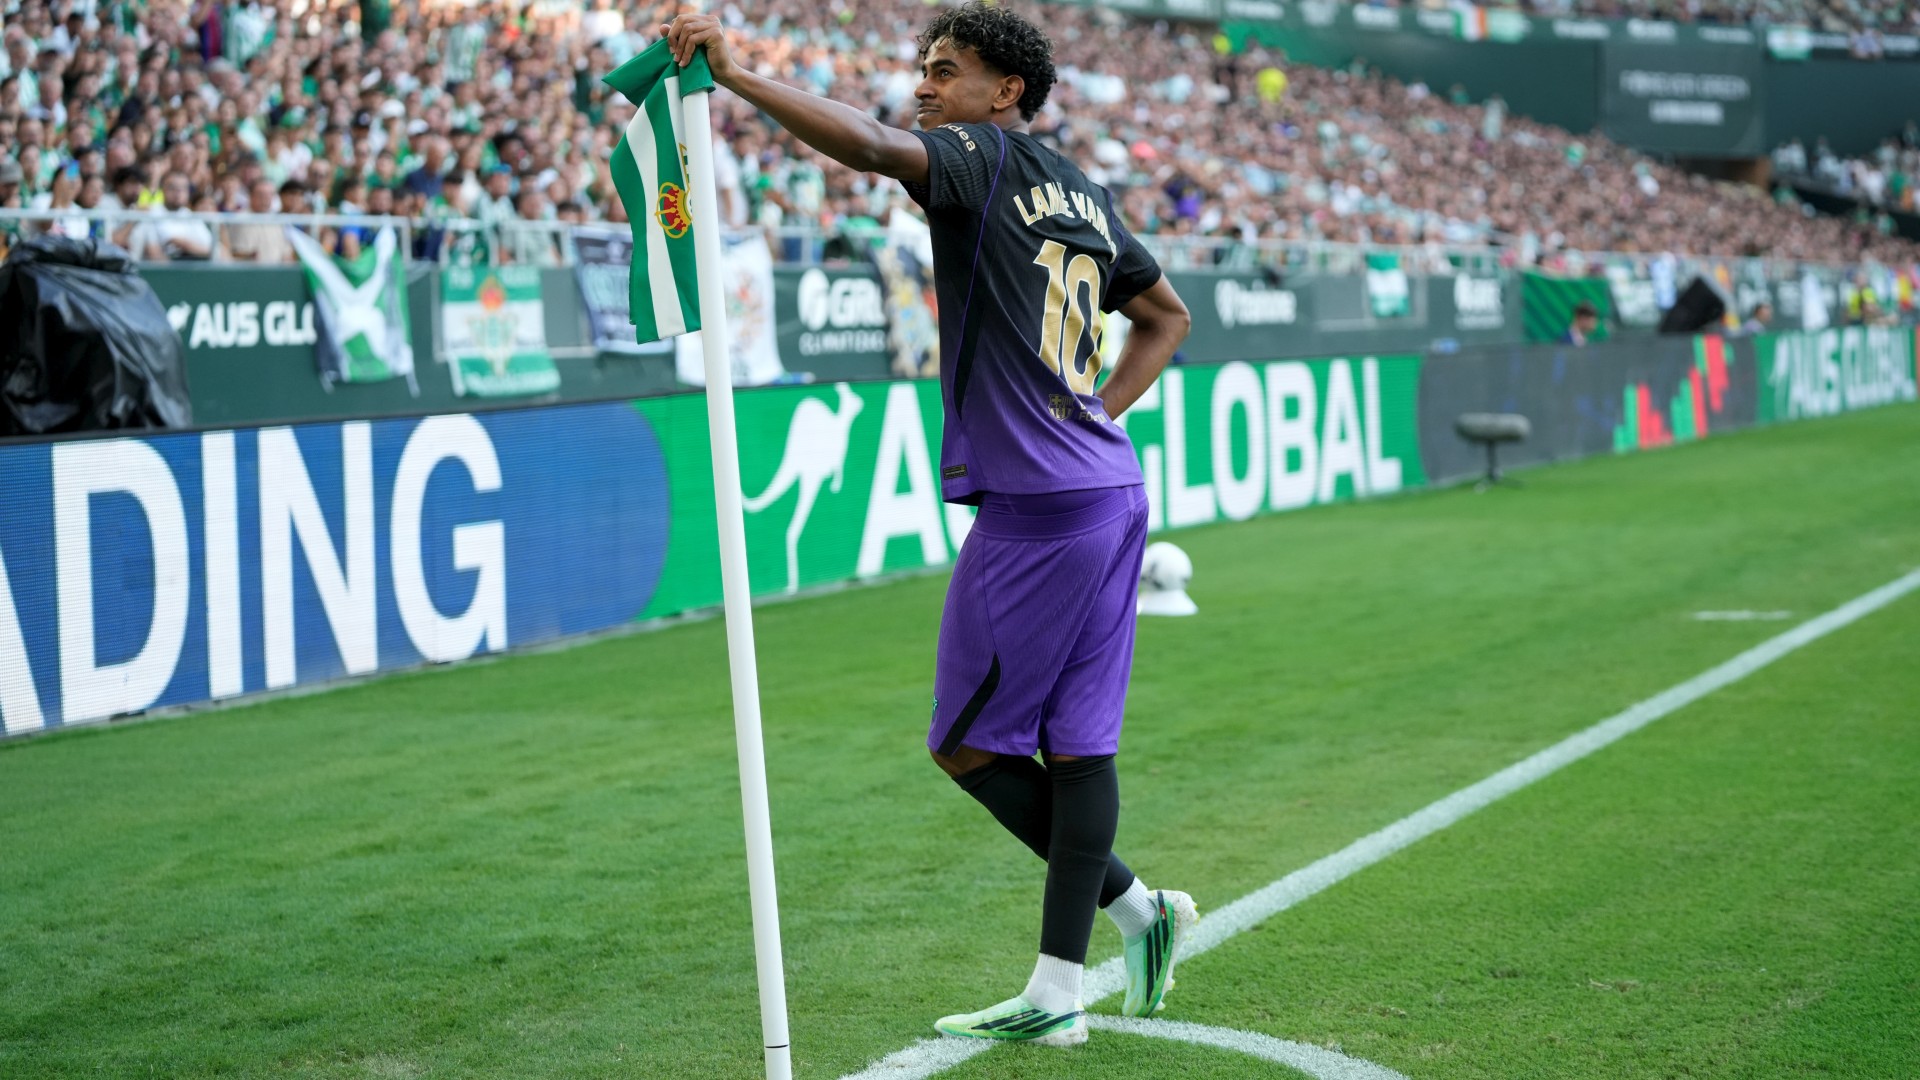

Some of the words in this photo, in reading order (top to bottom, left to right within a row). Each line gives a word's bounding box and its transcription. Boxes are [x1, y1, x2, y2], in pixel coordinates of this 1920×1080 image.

[937, 123, 976, 152] idea
[188, 302, 261, 349] AUS
[1033, 239, 1104, 396] 10
